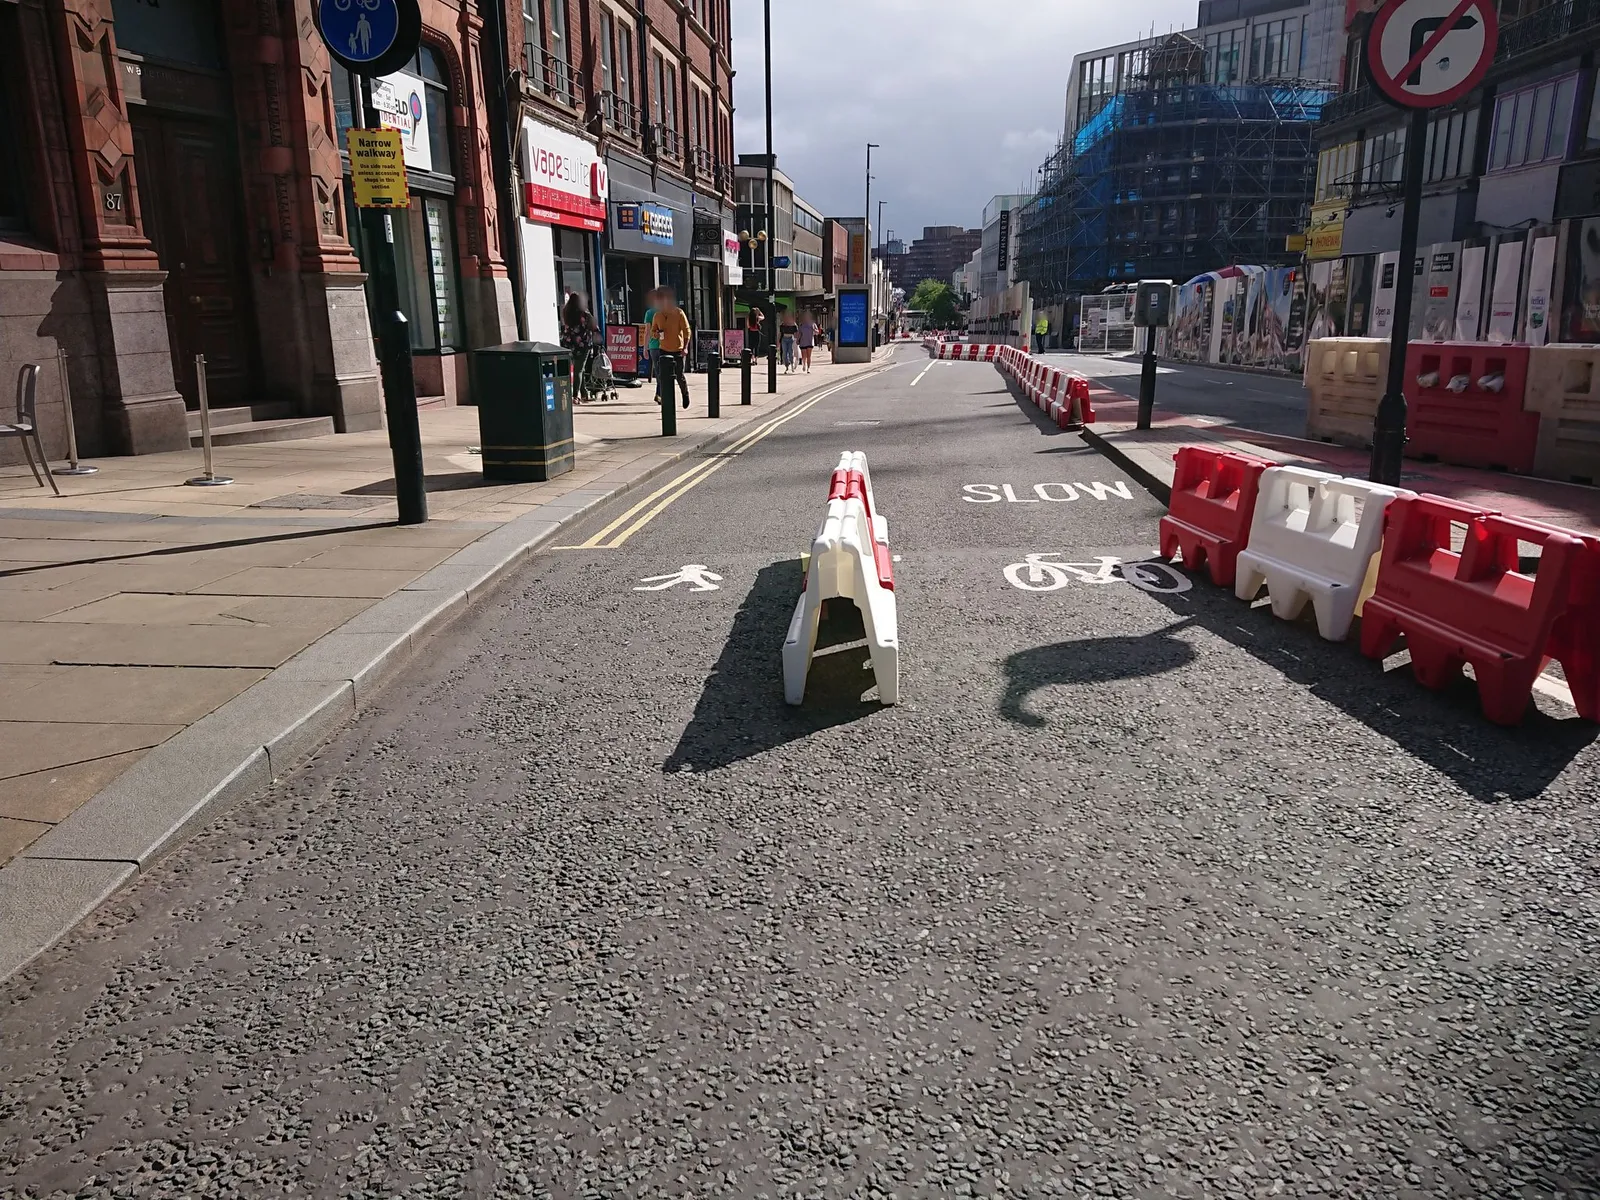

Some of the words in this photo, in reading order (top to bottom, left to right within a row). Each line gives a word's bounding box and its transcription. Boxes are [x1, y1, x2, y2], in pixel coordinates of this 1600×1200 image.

[358, 138, 391, 148] Narrow
[356, 148, 396, 160] walkway
[106, 193, 122, 210] 87
[322, 210, 335, 226] 87
[999, 214, 1008, 268] DEBENHAMS
[611, 334, 631, 344] TWO
[962, 481, 1134, 502] SLOW
